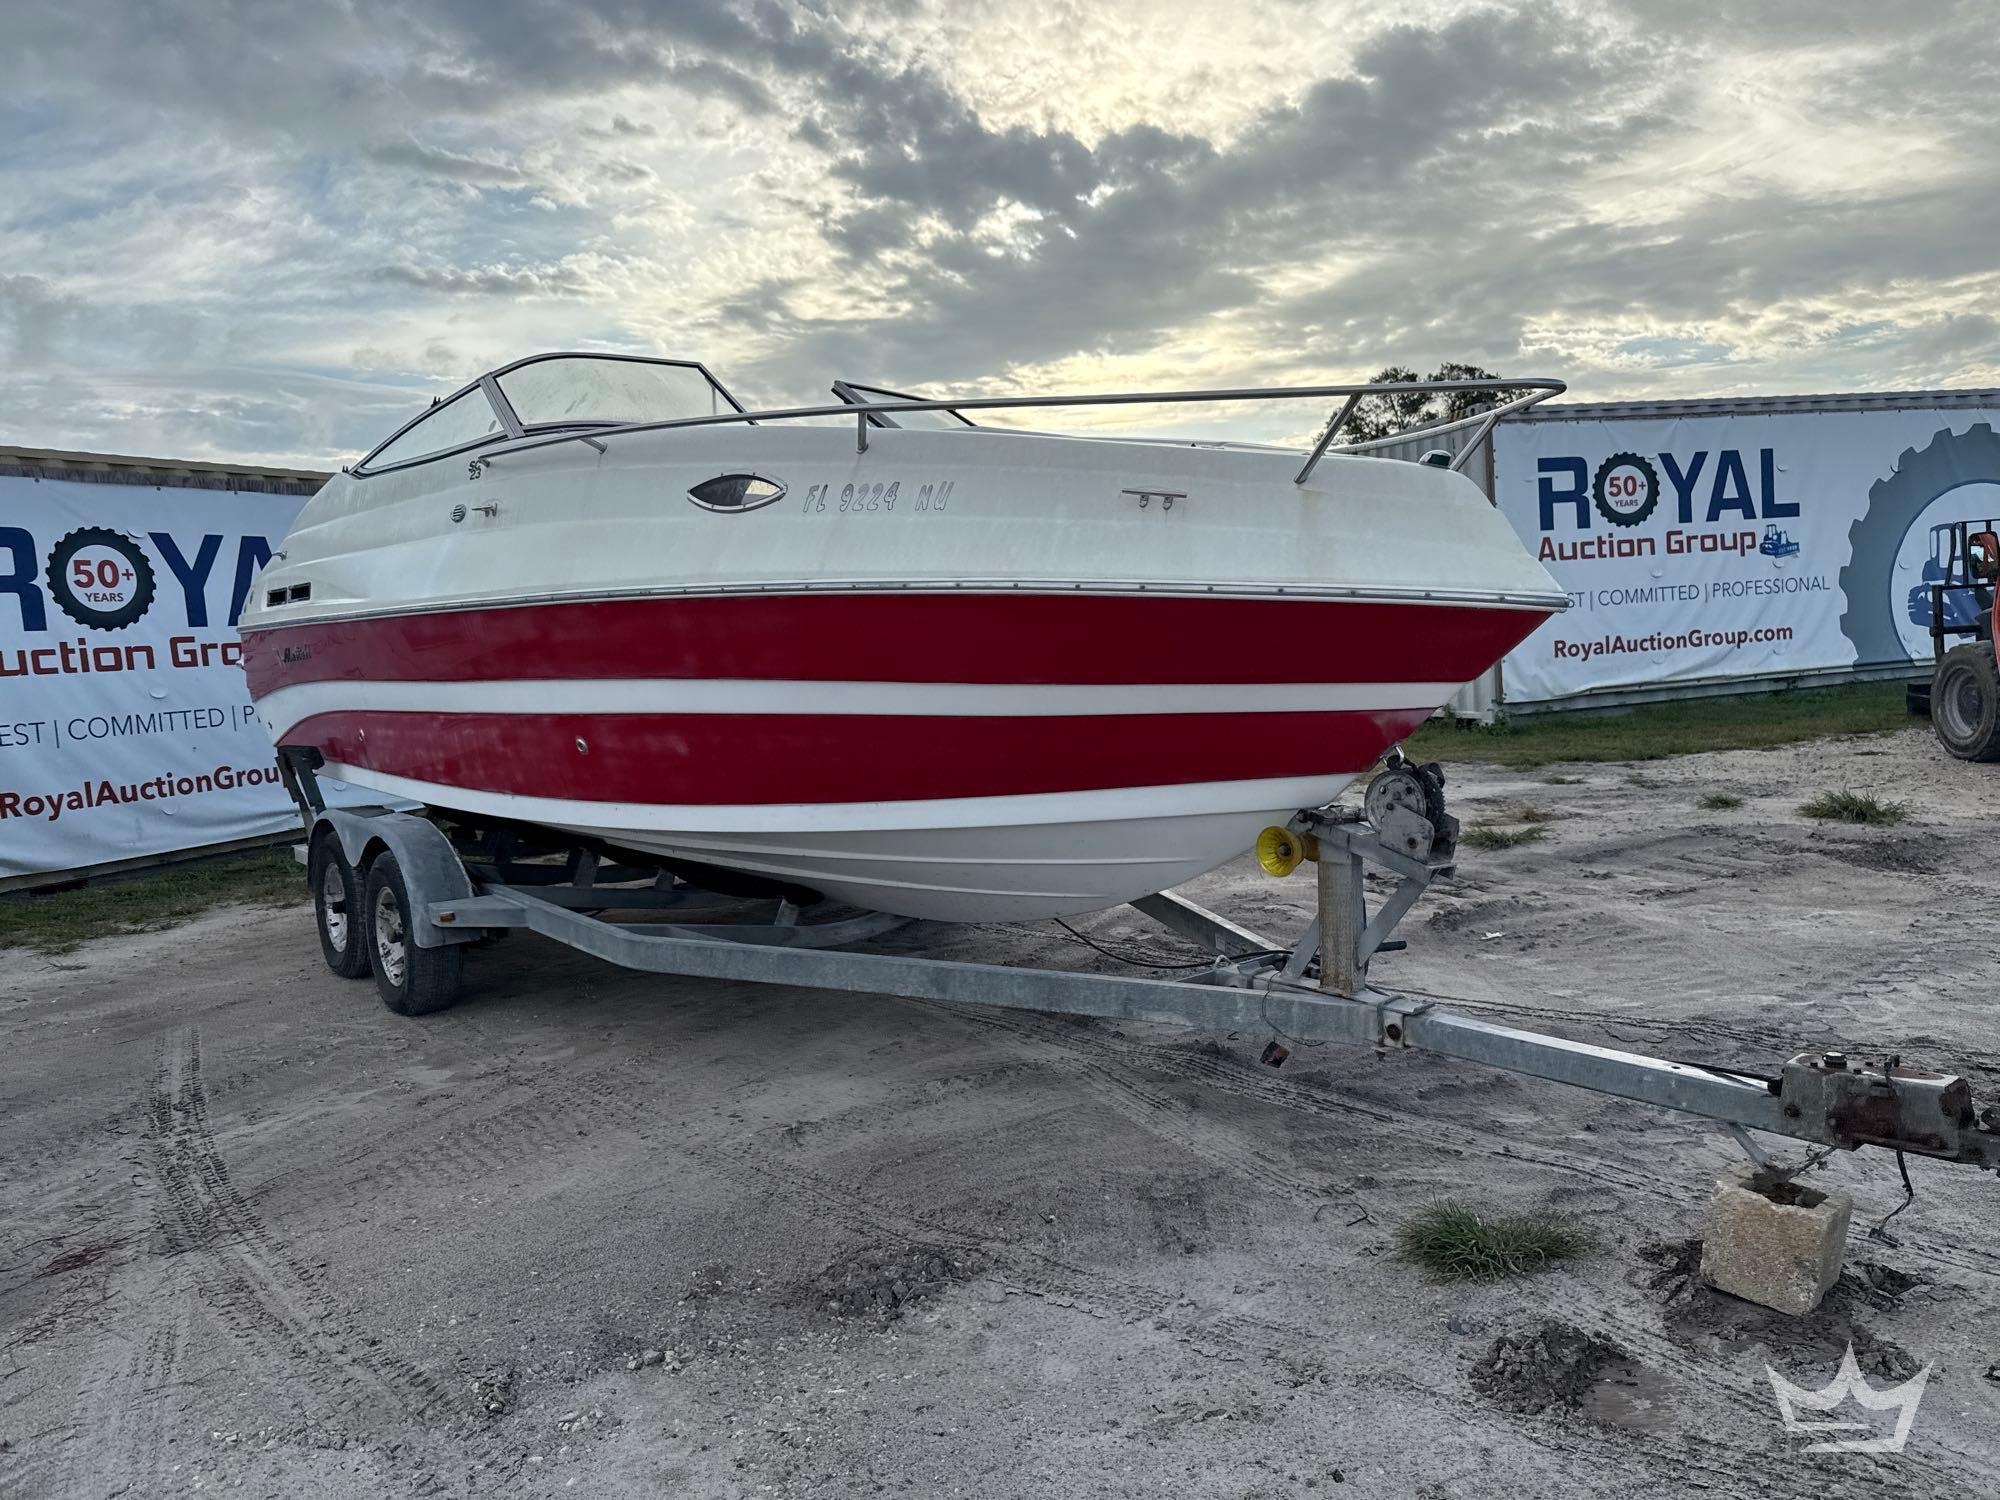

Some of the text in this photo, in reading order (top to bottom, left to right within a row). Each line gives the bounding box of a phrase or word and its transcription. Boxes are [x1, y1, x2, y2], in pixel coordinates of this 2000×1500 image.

[469, 469, 481, 480] 23
[1537, 448, 1800, 530] ROYAL
[1608, 475, 1646, 497] 50+
[803, 484, 828, 513] FL
[839, 481, 900, 512] 9224
[1614, 499, 1639, 507] YEARS
[1538, 528, 1757, 562] Auction Group
[72, 559, 135, 588] 50+
[84, 592, 124, 603] YEARS
[1598, 584, 1700, 607] COMMITTED
[1712, 575, 1831, 599] PROFESSIONAL
[1553, 626, 1793, 662] RoyalAuctionGroup.com
[67, 708, 226, 741] COMMITTED
